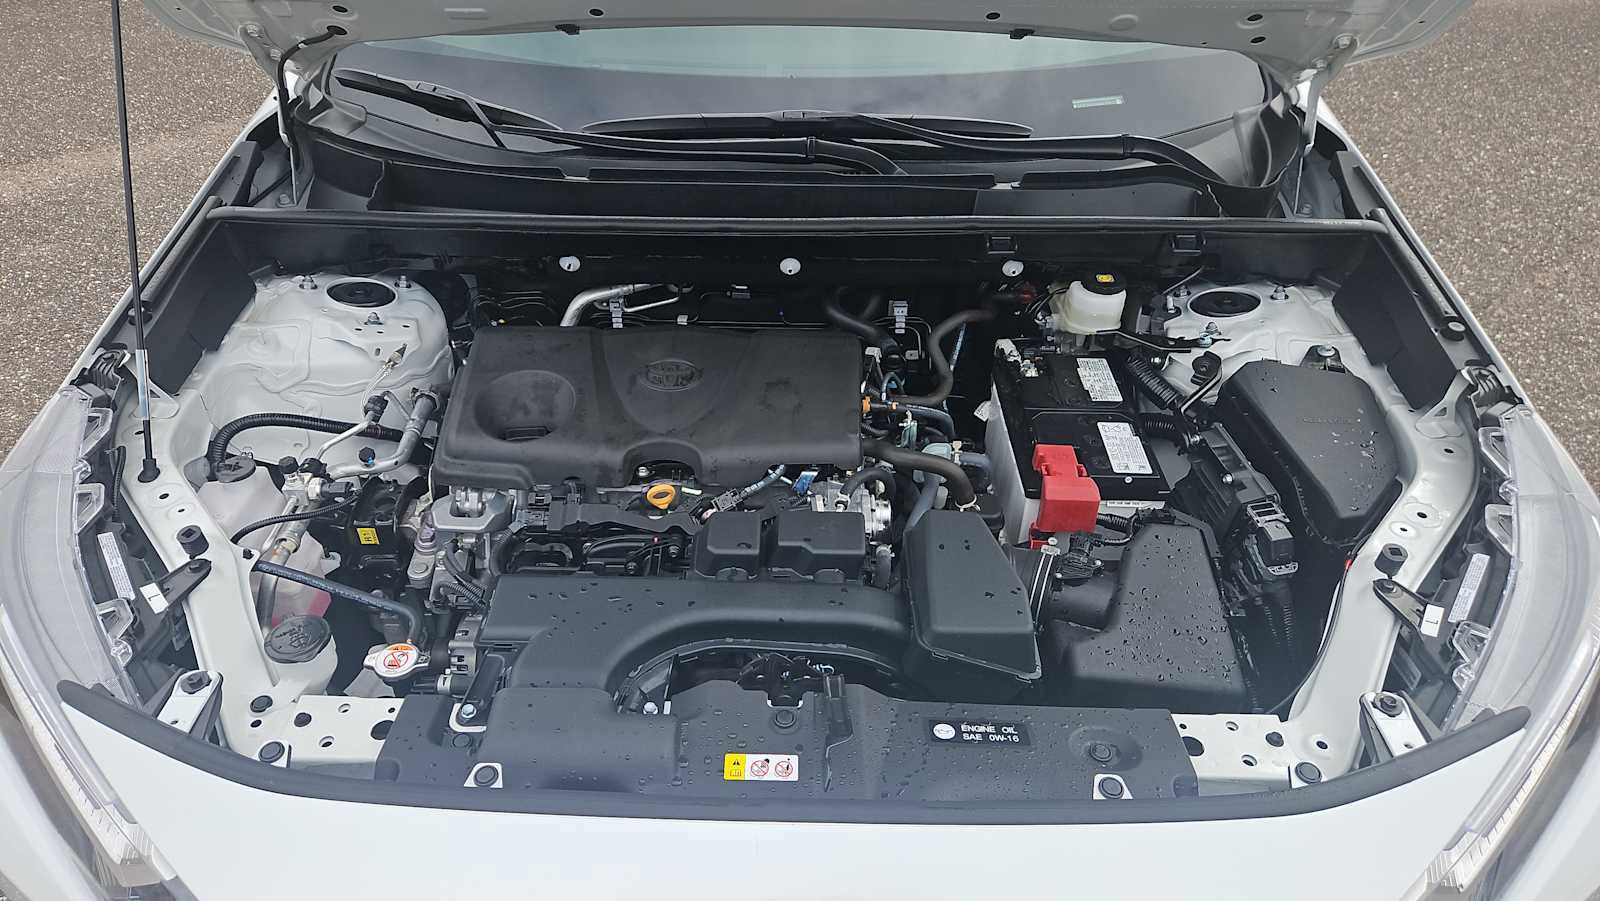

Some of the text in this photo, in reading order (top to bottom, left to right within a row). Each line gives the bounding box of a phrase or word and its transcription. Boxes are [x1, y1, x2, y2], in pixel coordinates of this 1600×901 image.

[961, 725, 1018, 734] ENGINE OIL
[962, 733, 1019, 742] SAE 0W-16
